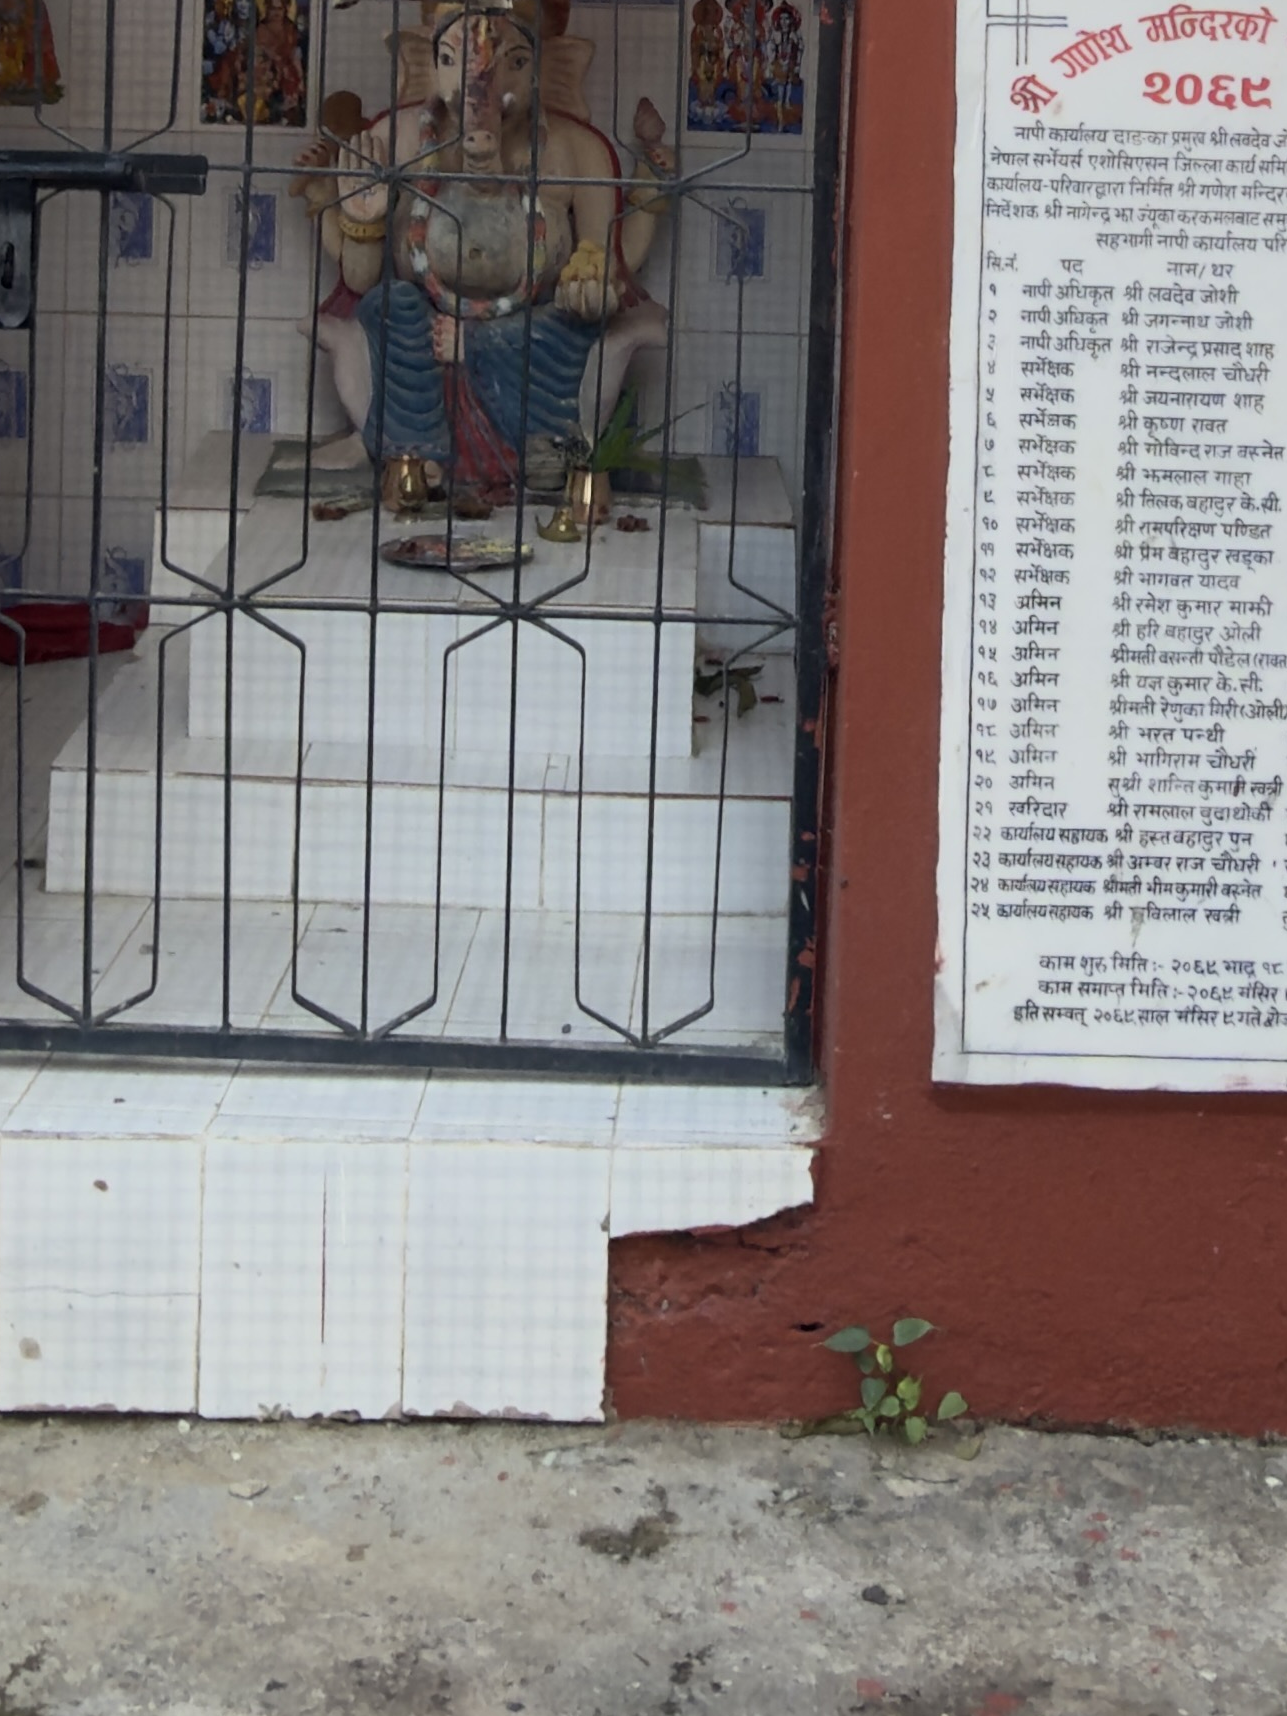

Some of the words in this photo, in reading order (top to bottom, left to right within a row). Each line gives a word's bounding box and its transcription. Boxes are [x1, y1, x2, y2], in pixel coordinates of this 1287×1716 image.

[1010, 74, 1058, 114] श्री
[1051, 23, 1132, 79] गणेश
[1138, 3, 1278, 44] मन्दिरको
[1143, 72, 1271, 110] २०६९
[1014, 120, 1046, 140] नापी
[1049, 122, 1108, 142] कार्यालय
[1210, 126, 1227, 146] श्री
[1174, 152, 1223, 172] जिल्ला
[1178, 177, 1196, 197] श्री
[1044, 198, 1063, 219] श्री
[1157, 229, 1189, 249] नापी
[1193, 231, 1258, 251] कार्यालय
[1022, 278, 1053, 298] नापी
[1056, 278, 1114, 306] अधिकृत
[1123, 280, 1144, 301] श्री
[1021, 305, 1051, 323] नापी
[1054, 305, 1109, 333] अधिकृत
[1122, 307, 1139, 325] श्री
[1020, 330, 1052, 349] नापी
[1055, 329, 1113, 360] अधिकृत
[1121, 333, 1139, 352] श्री
[1120, 357, 1141, 378] श्री
[1119, 384, 1139, 404] श्री
[1118, 409, 1138, 430] श्री
[1118, 435, 1139, 455] श्री
[1116, 461, 1136, 481] श्री
[1116, 487, 1135, 508] श्री
[1115, 513, 1135, 534] श्री
[1114, 540, 1134, 559] श्री
[1114, 565, 1134, 585] श्री
[1015, 588, 1063, 610] अमिन
[1112, 591, 1132, 611] श्री
[1176, 599, 1223, 619] कुमार
[1012, 615, 1060, 635] अमिन
[1112, 618, 1131, 638] श्री
[1011, 640, 1061, 661] अमिन
[1011, 666, 1060, 687] अमिन
[1110, 668, 1131, 688] श्री
[1167, 676, 1213, 696] कुमार
[1011, 692, 1061, 713] अमिन
[1010, 717, 1059, 739] अमिन
[1108, 720, 1129, 739] श्री
[1009, 744, 1058, 764] अमिन
[1108, 745, 1127, 766] श्री
[1009, 770, 1055, 790] अमिन
[1107, 794, 1129, 817] श्री
[1001, 822, 1056, 841] कार्यालय
[1115, 822, 1134, 843] श्री
[998, 848, 1054, 867] कार्यालय
[1104, 900, 1123, 920] श्री
[1172, 959, 1217, 975] २०६९
[1094, 1008, 1136, 1025] २०६९
